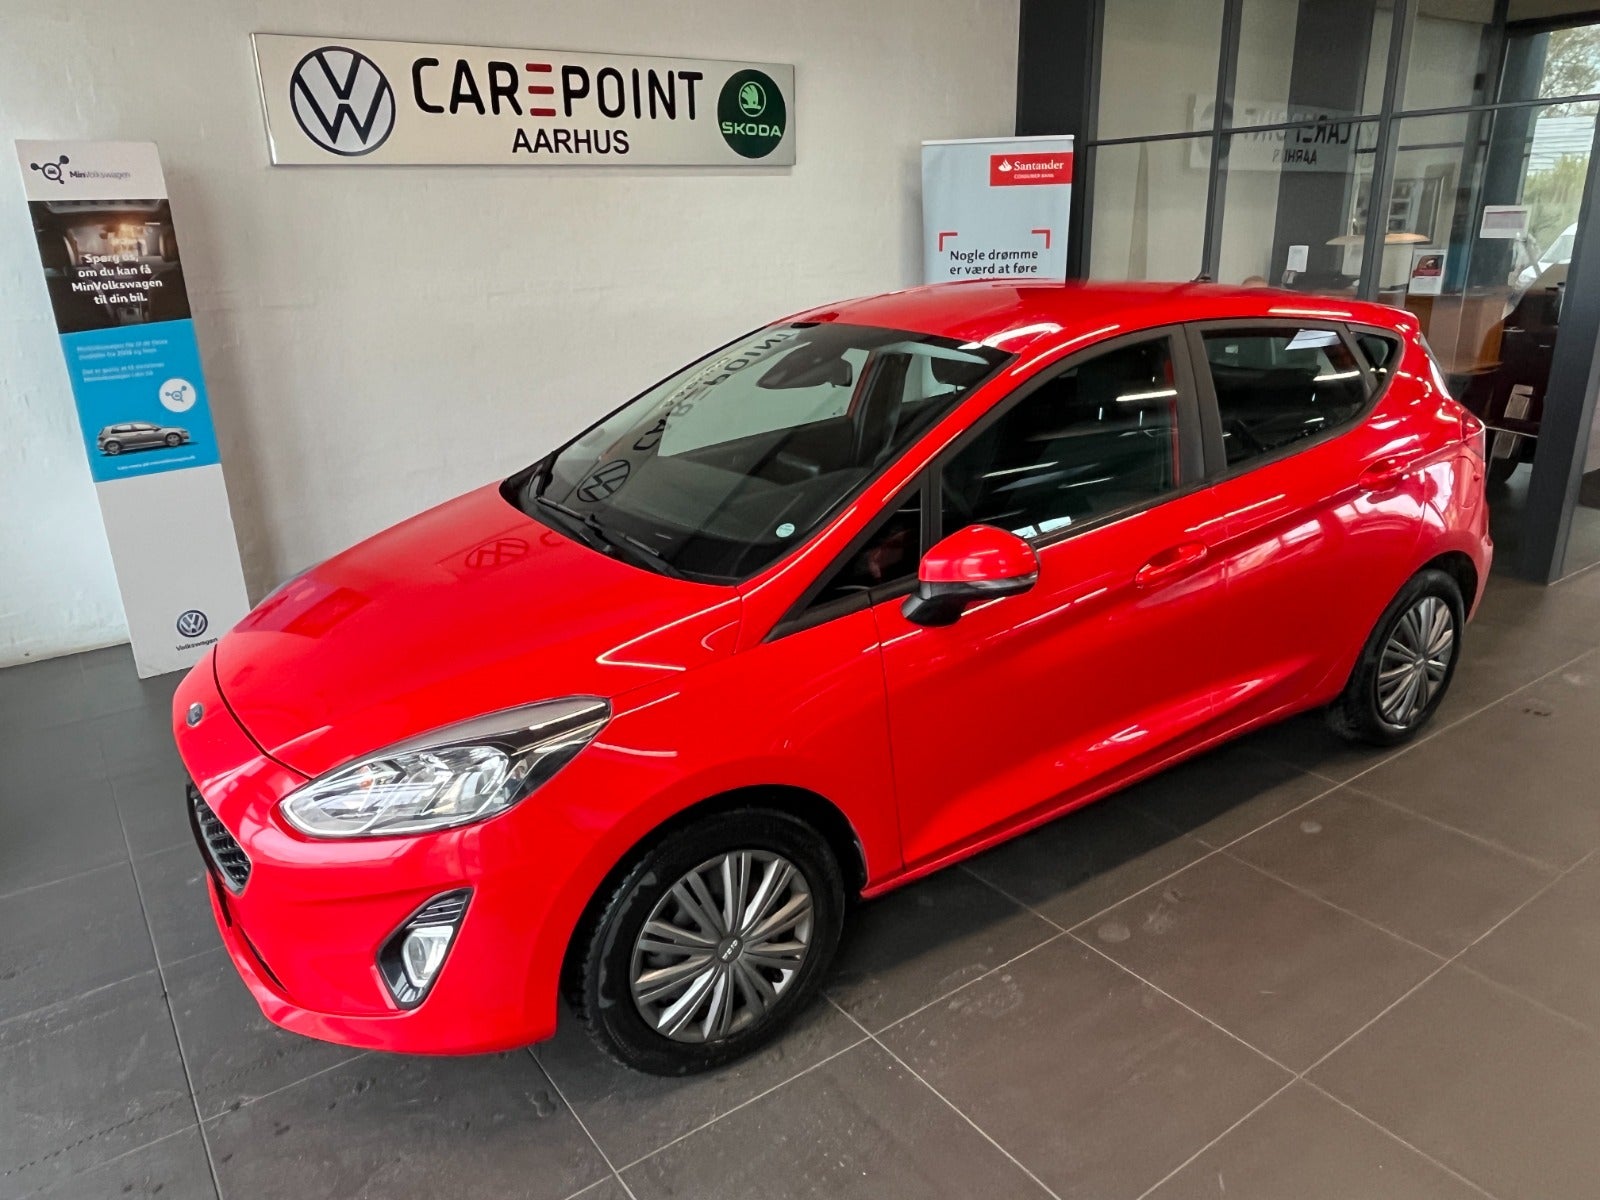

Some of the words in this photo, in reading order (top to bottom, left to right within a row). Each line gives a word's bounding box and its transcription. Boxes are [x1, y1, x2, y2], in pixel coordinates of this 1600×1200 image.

[411, 57, 704, 121] CAREPOINT
[511, 128, 630, 155] AARHUS
[1013, 159, 1065, 171] Santander
[950, 249, 986, 264] Nogle
[988, 249, 1039, 260] drømme
[78, 269, 97, 278] om
[100, 267, 114, 277] du
[116, 267, 138, 276] kan
[139, 264, 152, 274] få
[950, 266, 962, 275] er
[965, 263, 995, 275] værd
[998, 264, 1010, 274] at
[1013, 263, 1038, 274] føre
[71, 280, 163, 292] MinVolkswagen
[93, 295, 107, 305] til
[109, 294, 128, 304] din
[129, 292, 148, 302] bil.
